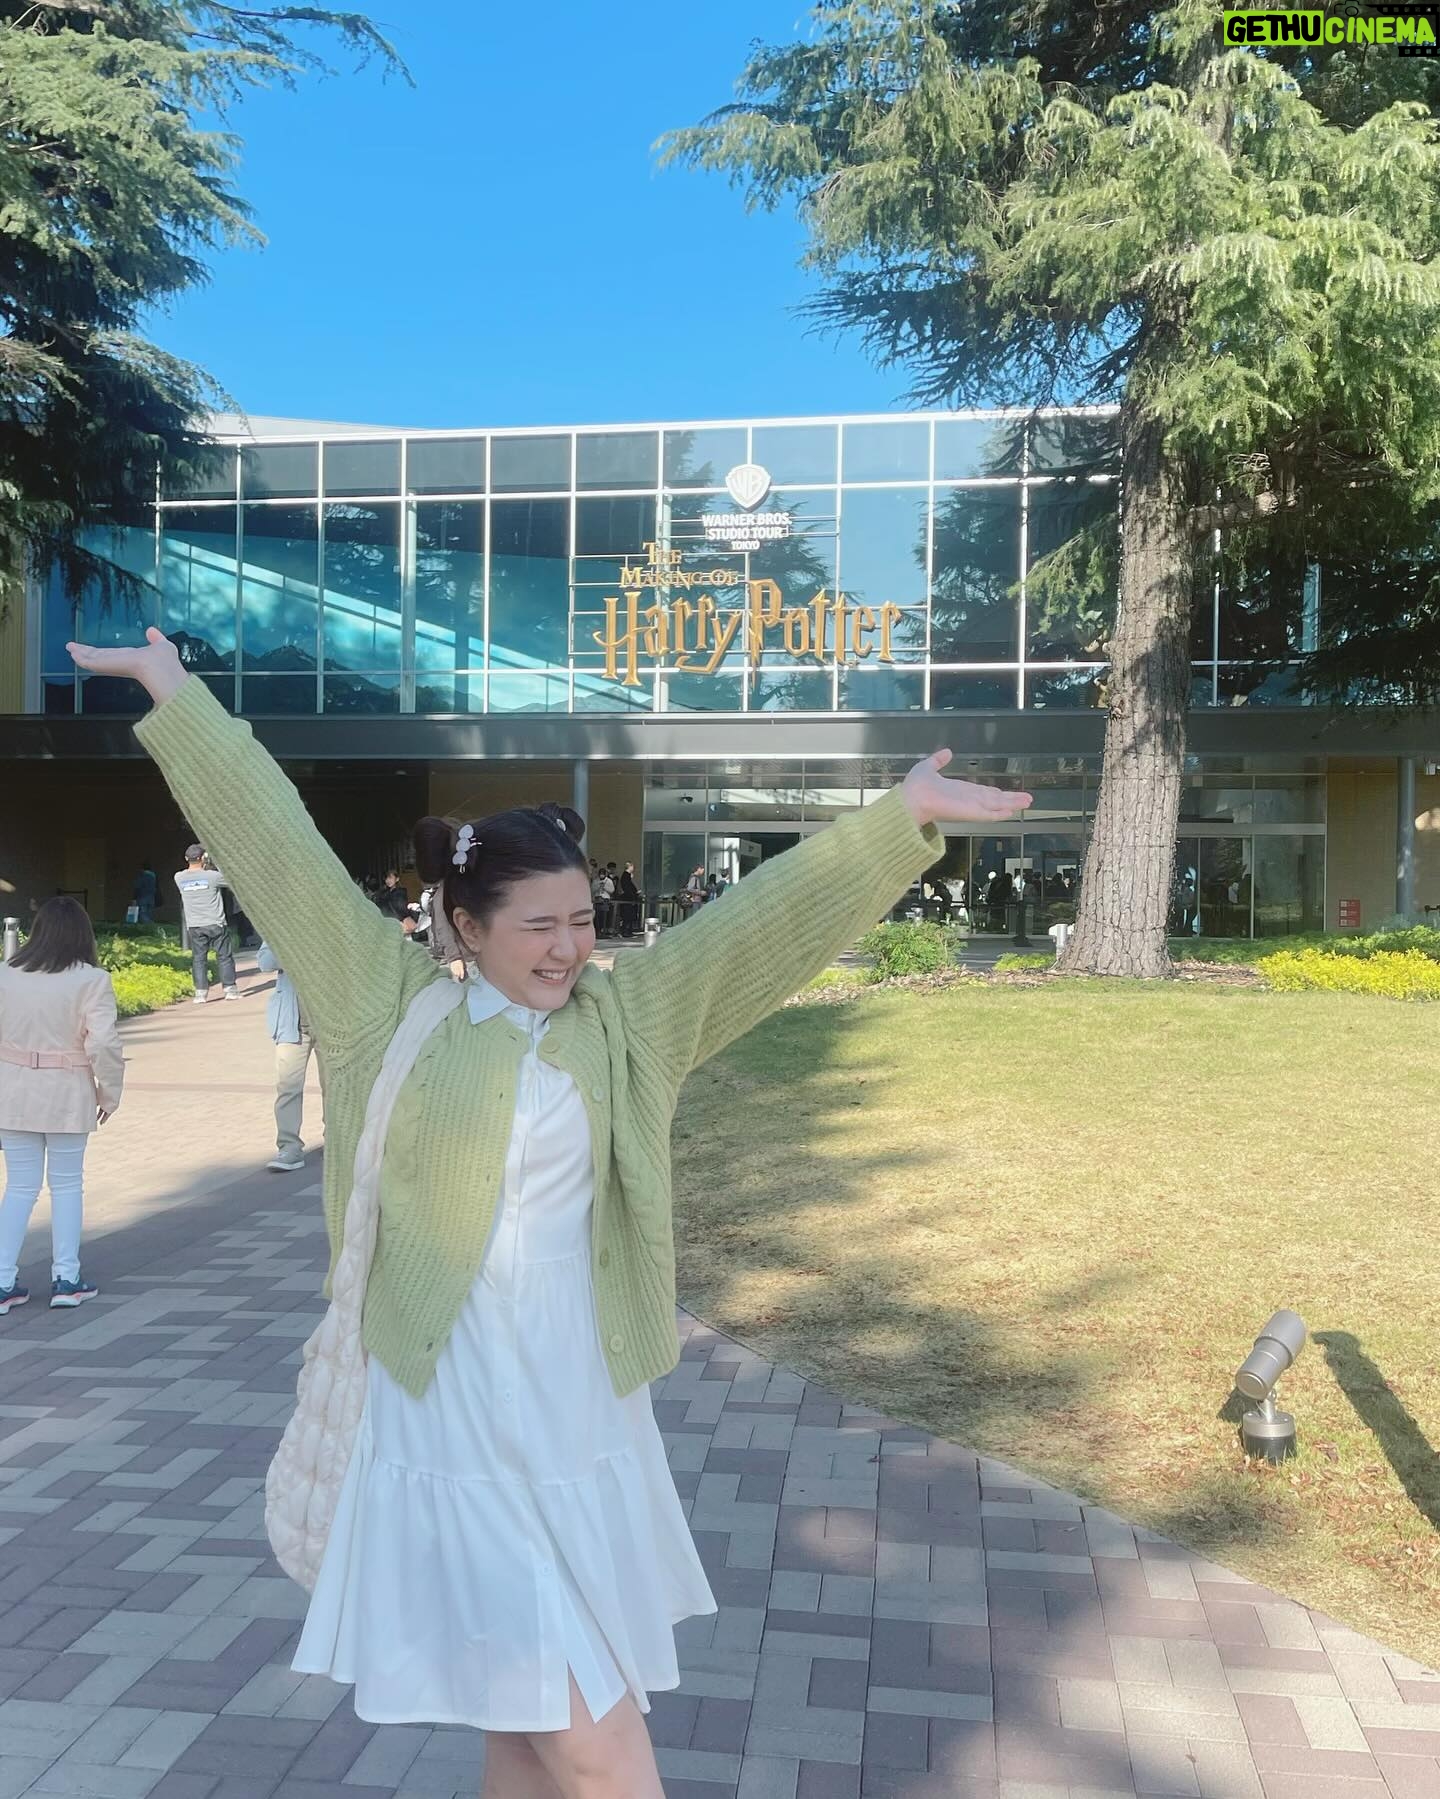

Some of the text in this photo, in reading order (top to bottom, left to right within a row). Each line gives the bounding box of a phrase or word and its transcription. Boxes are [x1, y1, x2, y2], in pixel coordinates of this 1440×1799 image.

[701, 512, 793, 527] WARNER BROS.
[708, 526, 783, 540] STUDIO TOUR
[731, 540, 760, 550] TOKYO
[592, 578, 902, 690] Harry Potter
